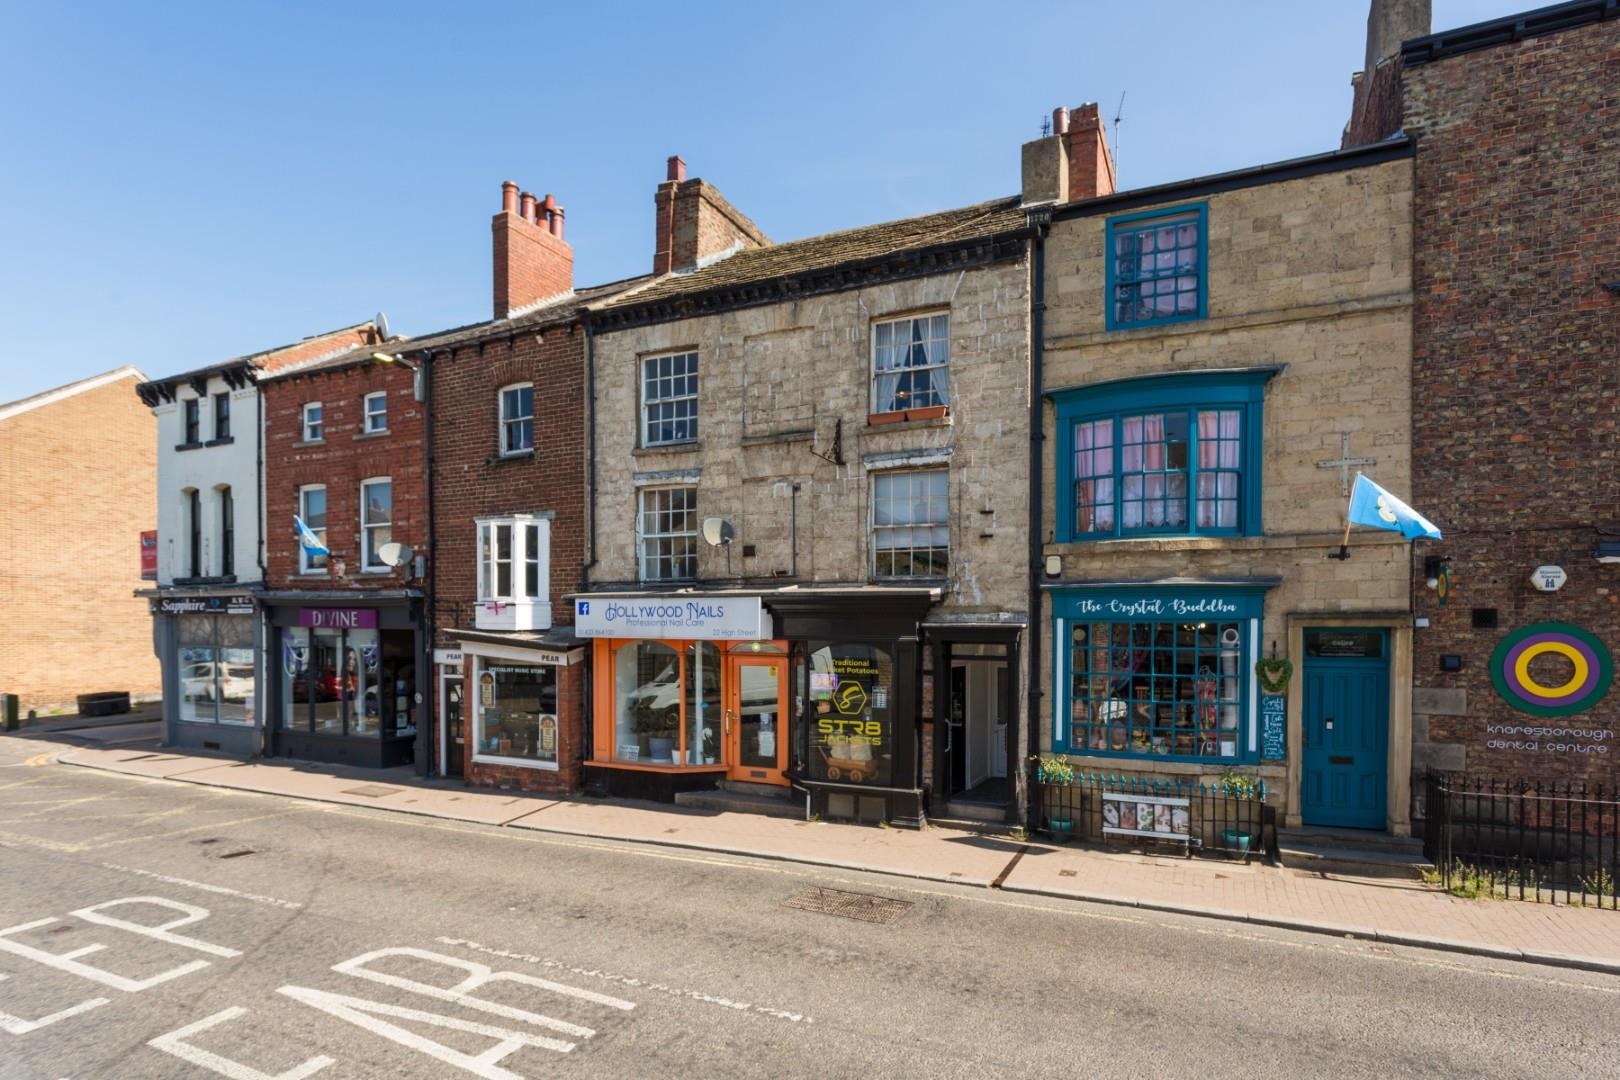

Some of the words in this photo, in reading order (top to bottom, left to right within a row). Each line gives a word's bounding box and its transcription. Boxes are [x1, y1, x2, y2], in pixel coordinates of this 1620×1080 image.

[161, 599, 205, 614] Sapphire
[1105, 599, 1165, 615] Crystal
[1168, 599, 1238, 614] Buddha
[312, 611, 358, 627] DIVINE
[626, 618, 666, 627] Professional
[669, 618, 683, 627] Nail
[686, 618, 705, 627] Care
[722, 628, 735, 637] High
[737, 628, 756, 636] Street
[541, 654, 559, 662] PEAR
[832, 659, 870, 667] Traditional
[818, 720, 881, 735] STR8
[1487, 724, 1614, 740] knaresborough
[817, 735, 881, 746] JACKETS
[1487, 739, 1538, 751] dental
[1546, 742, 1608, 754] centre
